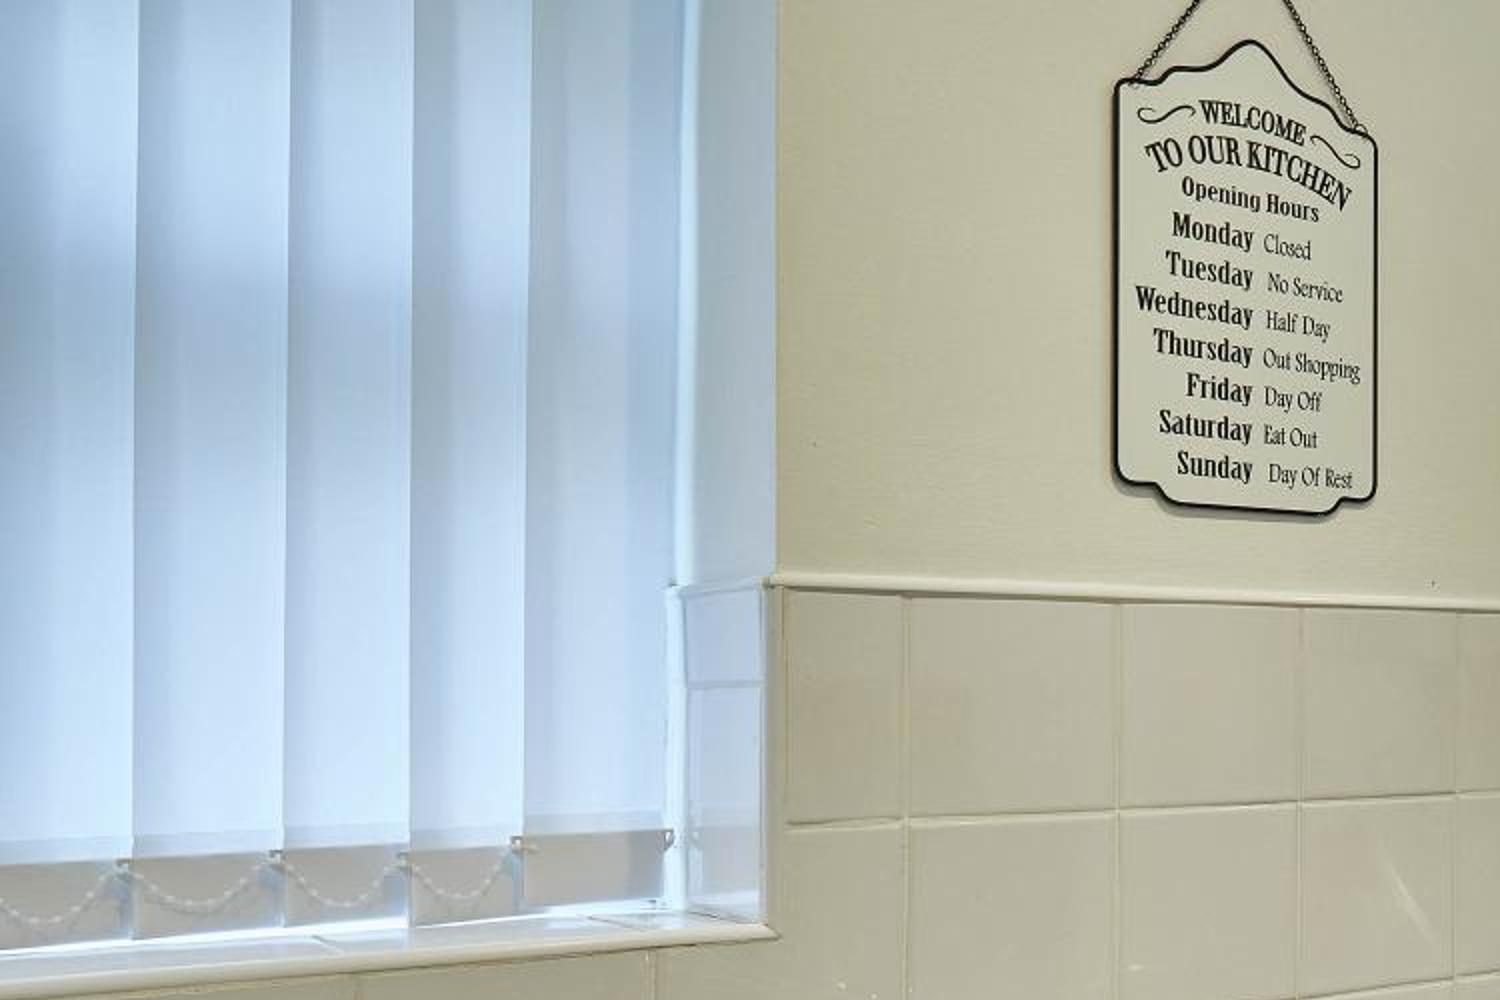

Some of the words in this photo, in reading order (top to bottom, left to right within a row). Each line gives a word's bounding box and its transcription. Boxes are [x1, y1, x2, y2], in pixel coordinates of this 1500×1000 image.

[1198, 99, 1307, 147] WELCOME
[1144, 137, 1183, 173] TO
[1188, 135, 1242, 168] OUR
[1245, 139, 1353, 212] KITCHEN
[1181, 175, 1261, 213] Opening
[1265, 193, 1319, 222] Hours
[1171, 211, 1254, 252] Monday
[1263, 233, 1312, 261] Closed
[1165, 249, 1254, 291] Tuesday
[1267, 271, 1289, 294] No
[1292, 277, 1344, 303] Service
[1135, 285, 1254, 331] Wednesday
[1265, 310, 1299, 334] Half
[1302, 315, 1331, 343] Day
[1153, 327, 1253, 369] Thursday
[1263, 348, 1291, 371] Out
[1294, 352, 1361, 385] Shopping
[1186, 372, 1253, 407] Friday
[1264, 385, 1293, 413] Day
[1297, 391, 1323, 412] Off
[1159, 409, 1253, 446] Saturday
[1263, 424, 1286, 447] Eat
[1289, 427, 1318, 449] Out
[1177, 451, 1253, 485] Sunday
[1268, 463, 1297, 490] Day
[1301, 467, 1321, 487] Of
[1325, 471, 1353, 489] Rest
